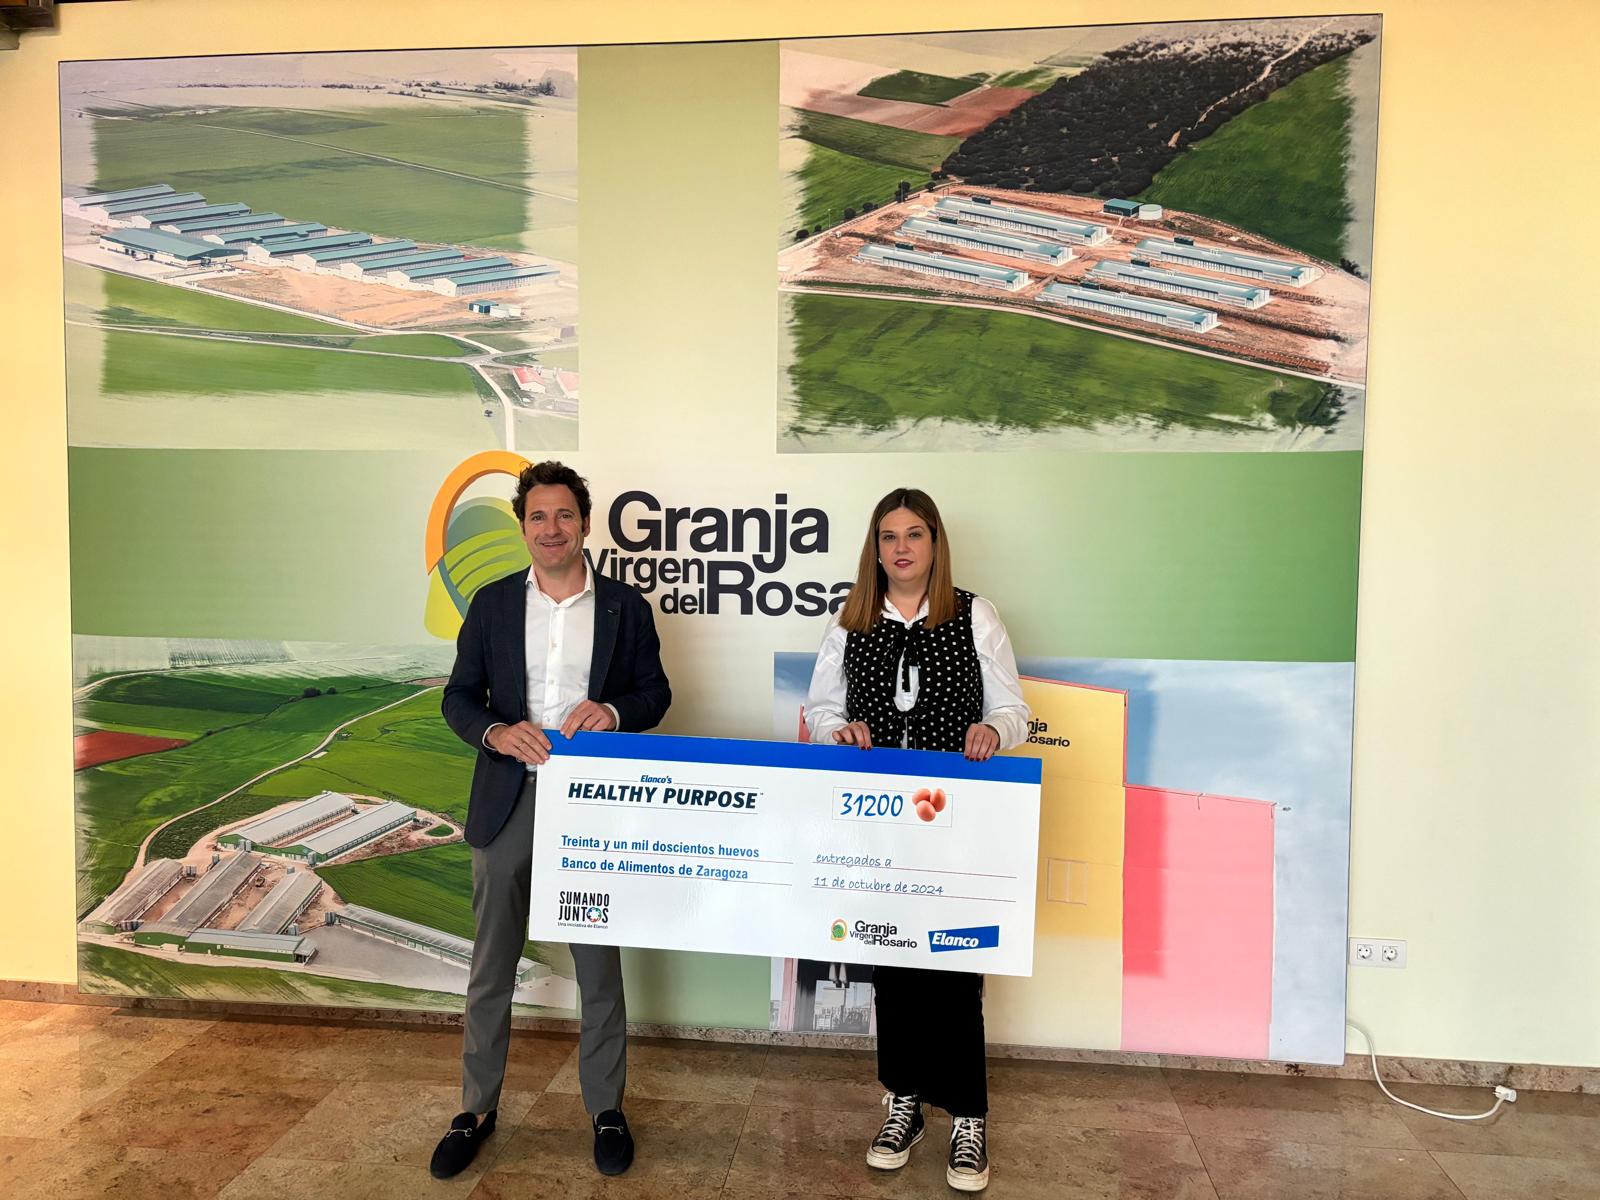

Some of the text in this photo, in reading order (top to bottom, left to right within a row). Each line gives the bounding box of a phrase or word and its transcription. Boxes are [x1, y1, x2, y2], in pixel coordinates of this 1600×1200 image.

[608, 490, 829, 573] Granja
[584, 548, 705, 593] Virgen
[660, 588, 704, 614] del
[640, 774, 672, 784] Elanco's
[568, 783, 657, 803] HEALTHY
[840, 792, 904, 817] 31200
[561, 835, 760, 858] Treinta y un mil doscientos huevos
[561, 857, 748, 880] Banco de Alimentos de Zaragoza
[816, 854, 892, 868] entregados a
[814, 877, 944, 896] 11 de octubre de 2024
[559, 891, 610, 906] SUMANDO
[850, 931, 874, 941] Virgen
[855, 920, 898, 938] Granja
[874, 934, 917, 949] Rosario
[932, 932, 979, 948] Elanco
